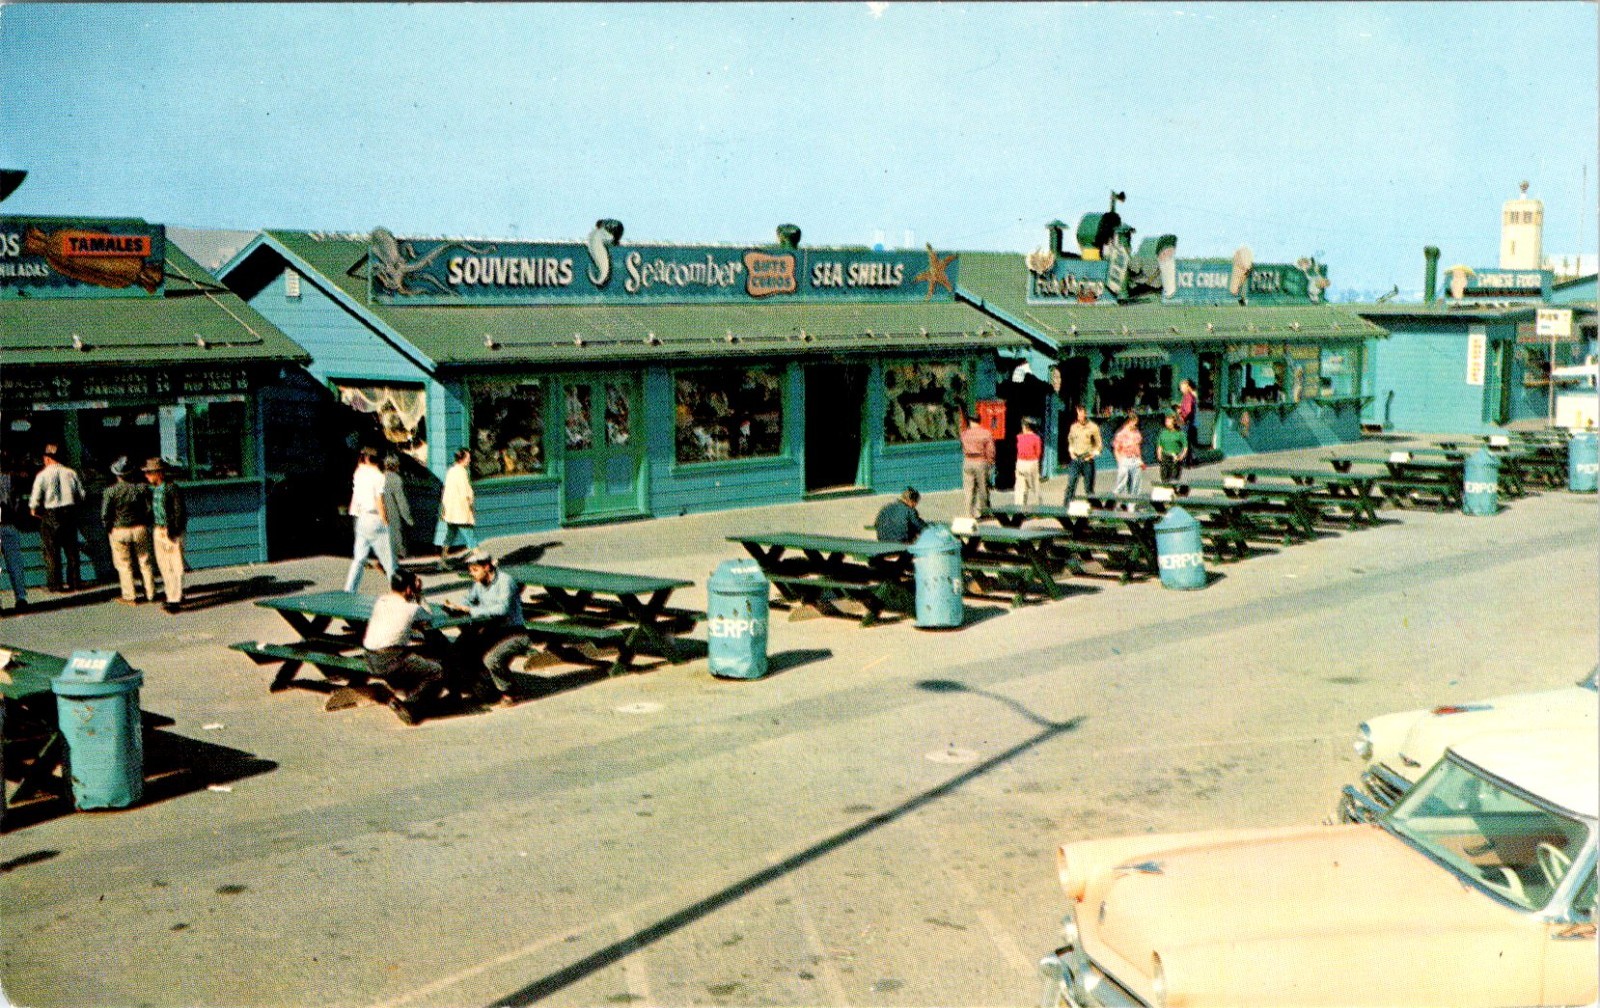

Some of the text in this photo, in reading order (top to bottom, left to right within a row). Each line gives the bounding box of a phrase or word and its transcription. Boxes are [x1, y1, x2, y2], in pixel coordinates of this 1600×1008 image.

[68, 236, 144, 252] TAMALES
[449, 256, 574, 286] SOUVENIRS
[625, 251, 742, 293] Seacomber
[812, 262, 905, 288] SEA SHELLS
[1178, 271, 1229, 288] ICE CREAM
